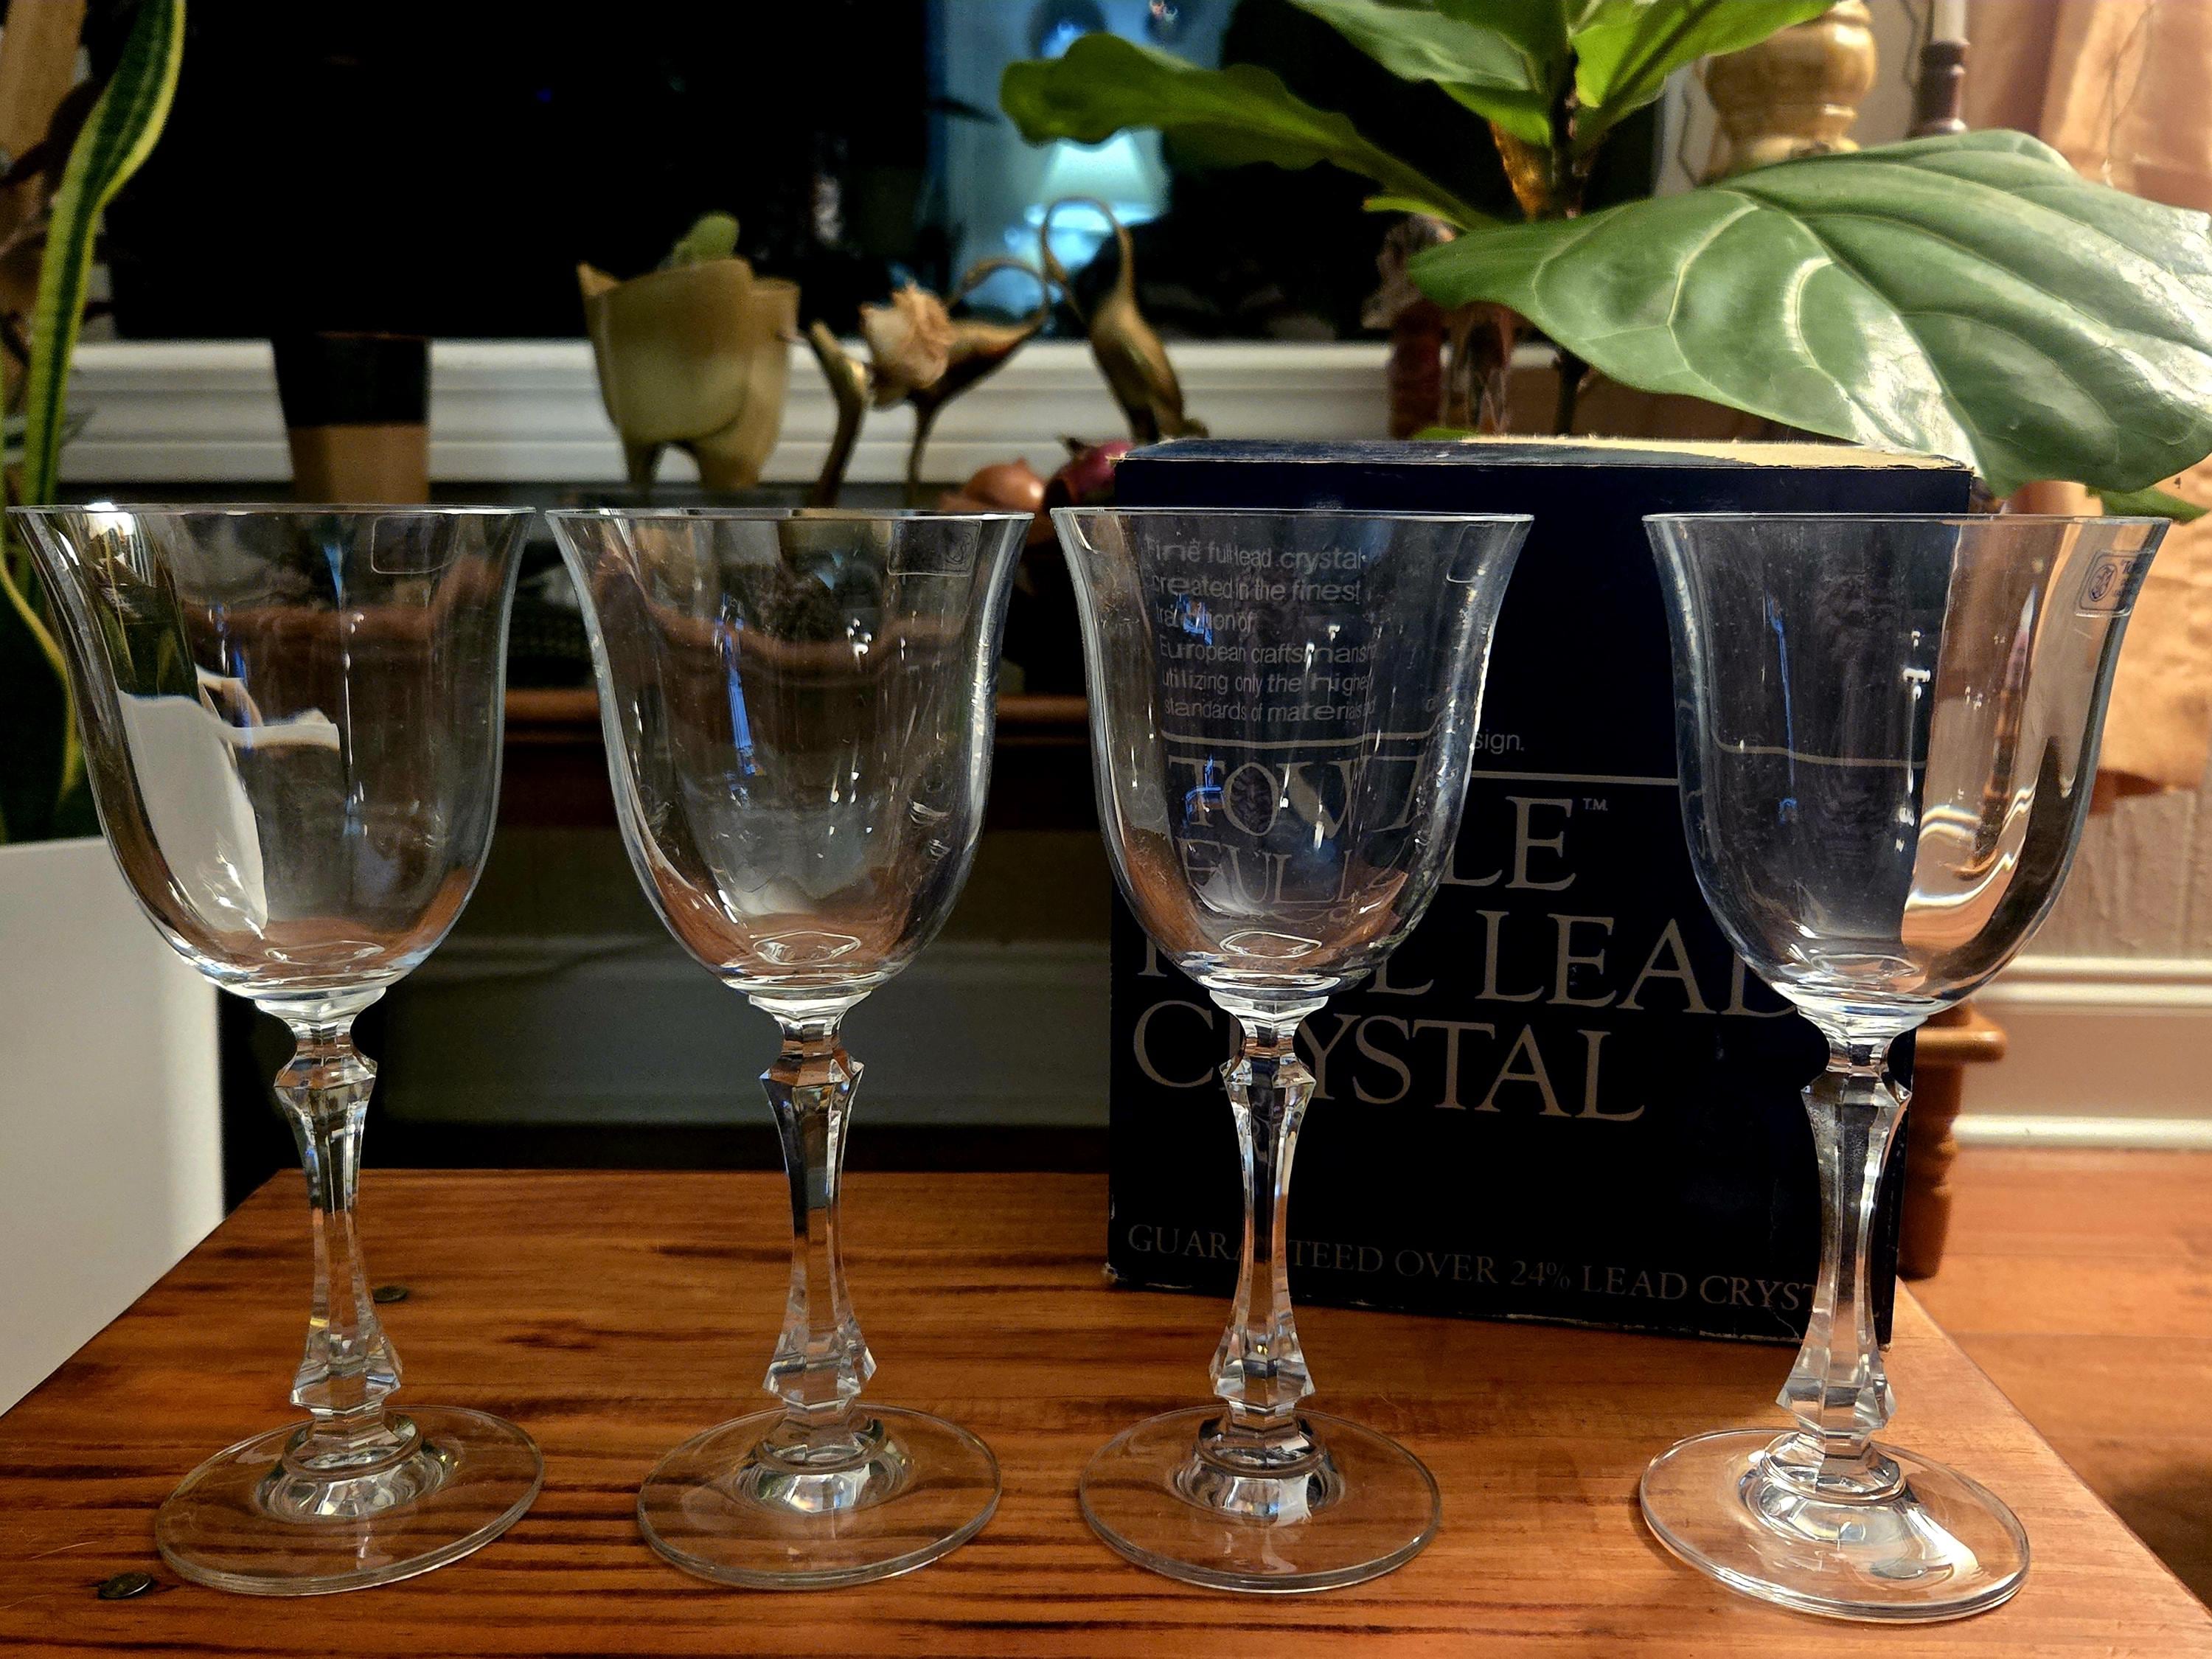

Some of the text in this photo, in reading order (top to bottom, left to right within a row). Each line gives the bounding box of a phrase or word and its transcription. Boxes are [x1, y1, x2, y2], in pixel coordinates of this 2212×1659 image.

[1279, 547, 1362, 574] crystal
[1253, 579, 1287, 602] the
[1292, 580, 1361, 602] finest
[1158, 634, 1246, 665] European
[1162, 667, 1229, 696] utilizing
[1235, 673, 1263, 698] only
[1267, 672, 1303, 694] the
[1164, 698, 1247, 721] standards
[1251, 703, 1263, 722] of
[1267, 703, 1363, 723] materials
[1474, 728, 1526, 755] sign.
[1132, 999, 1646, 1124] CYSTAL
[1127, 1222, 1384, 1274] GUARTEED
[1394, 1248, 1500, 1284] OVER
[1509, 1259, 1571, 1291] 24%
[1579, 1265, 1688, 1301] LEAD
